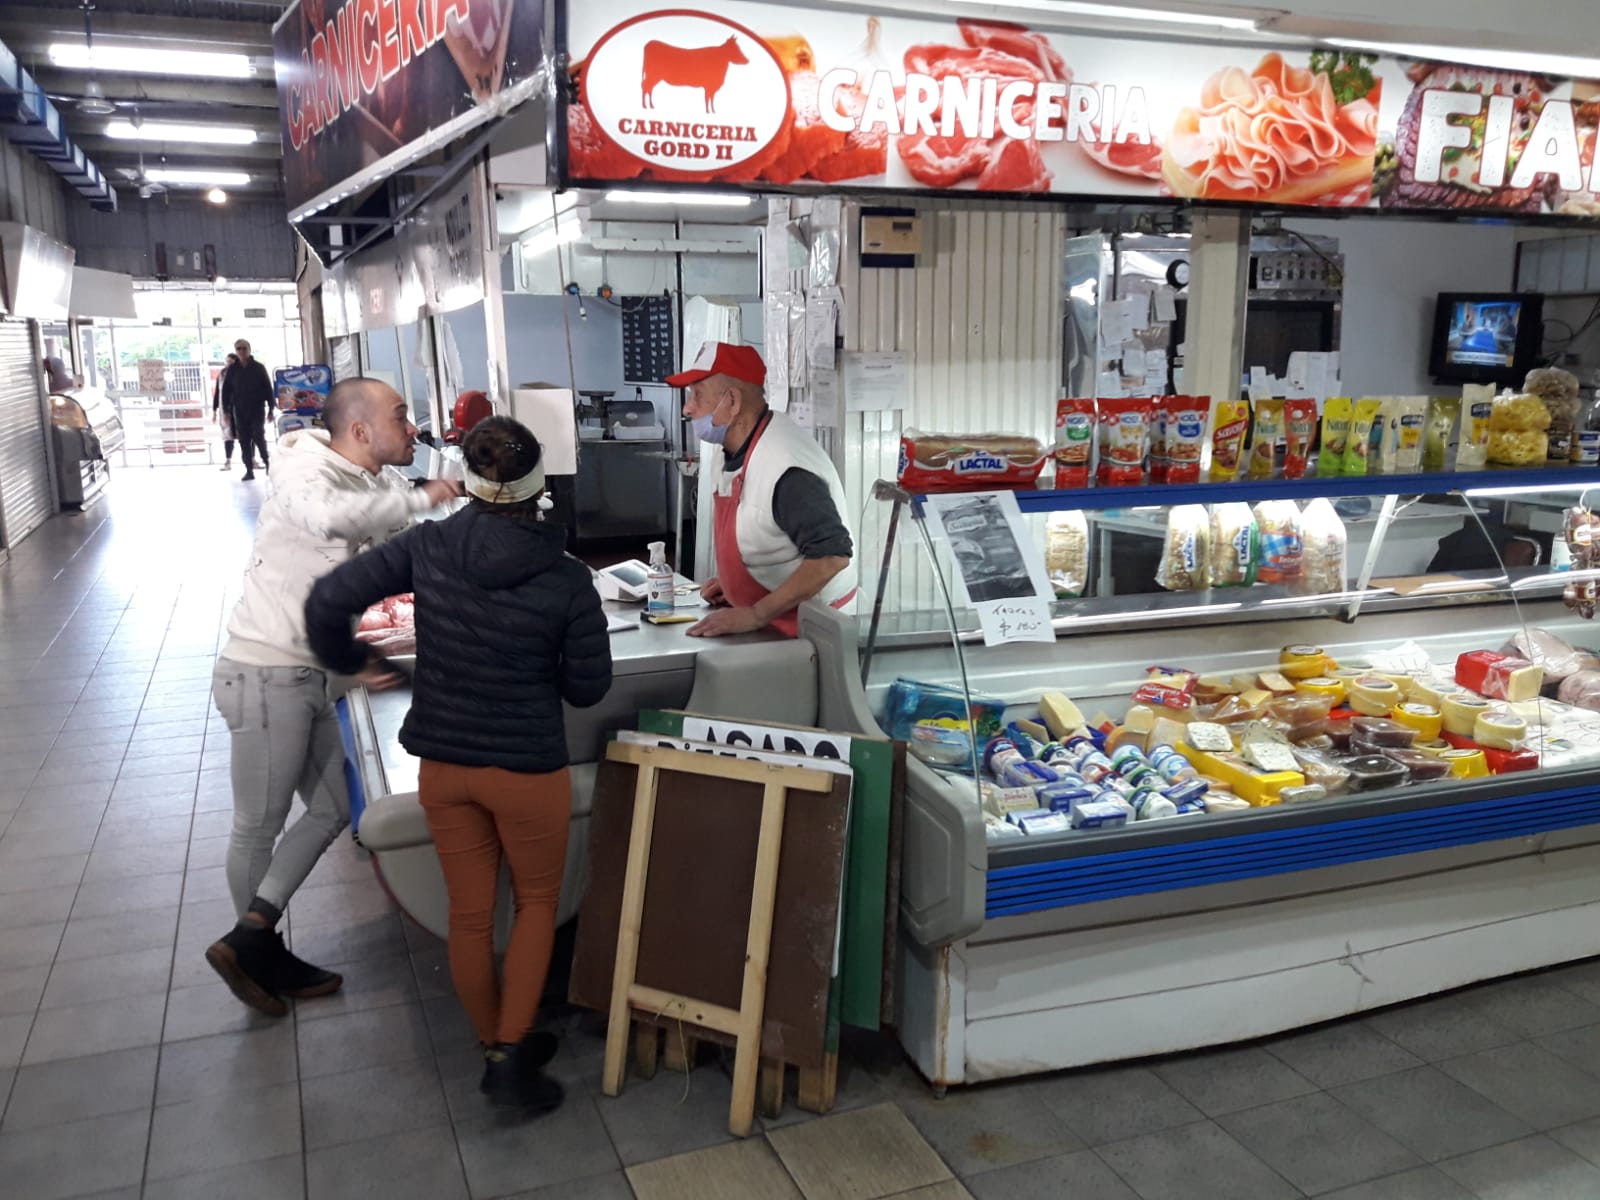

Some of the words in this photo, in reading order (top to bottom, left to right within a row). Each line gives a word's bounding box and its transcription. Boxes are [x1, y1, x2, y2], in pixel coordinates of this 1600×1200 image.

[817, 67, 1152, 145] CARNICERIA
[618, 118, 758, 142] CARNICERIA
[643, 139, 710, 160] GORD
[715, 144, 733, 160] II
[960, 457, 1005, 471] LACTAL
